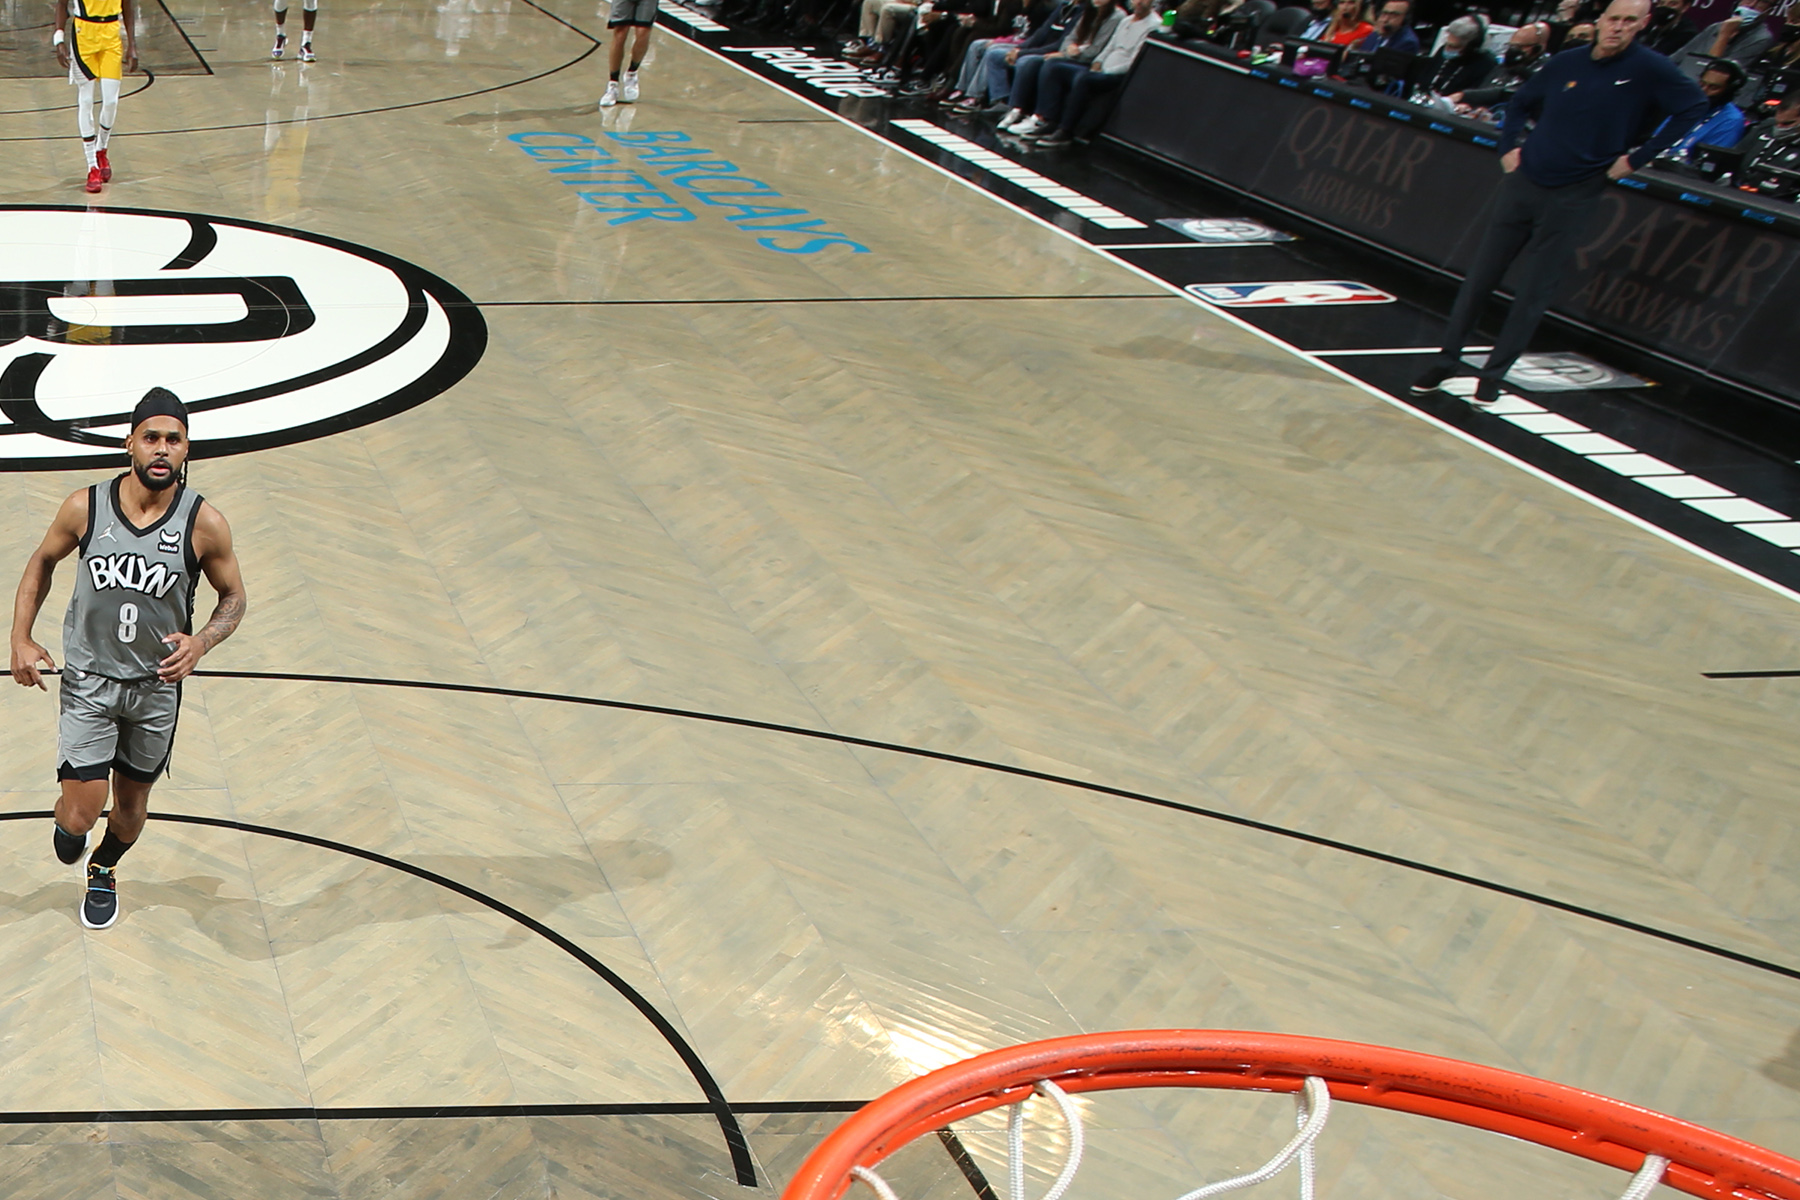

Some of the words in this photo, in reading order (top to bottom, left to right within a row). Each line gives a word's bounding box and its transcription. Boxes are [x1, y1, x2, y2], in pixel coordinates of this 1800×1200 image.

[720, 46, 887, 98] jetBlue
[507, 131, 698, 227] CENTER
[1289, 106, 1435, 194] QATAR
[602, 130, 873, 255] BARCLAYS
[1291, 169, 1400, 229] AIRWAYS
[1569, 270, 1736, 350] AIRWAYS
[87, 552, 180, 599] BKLYN
[117, 602, 139, 643] 8
